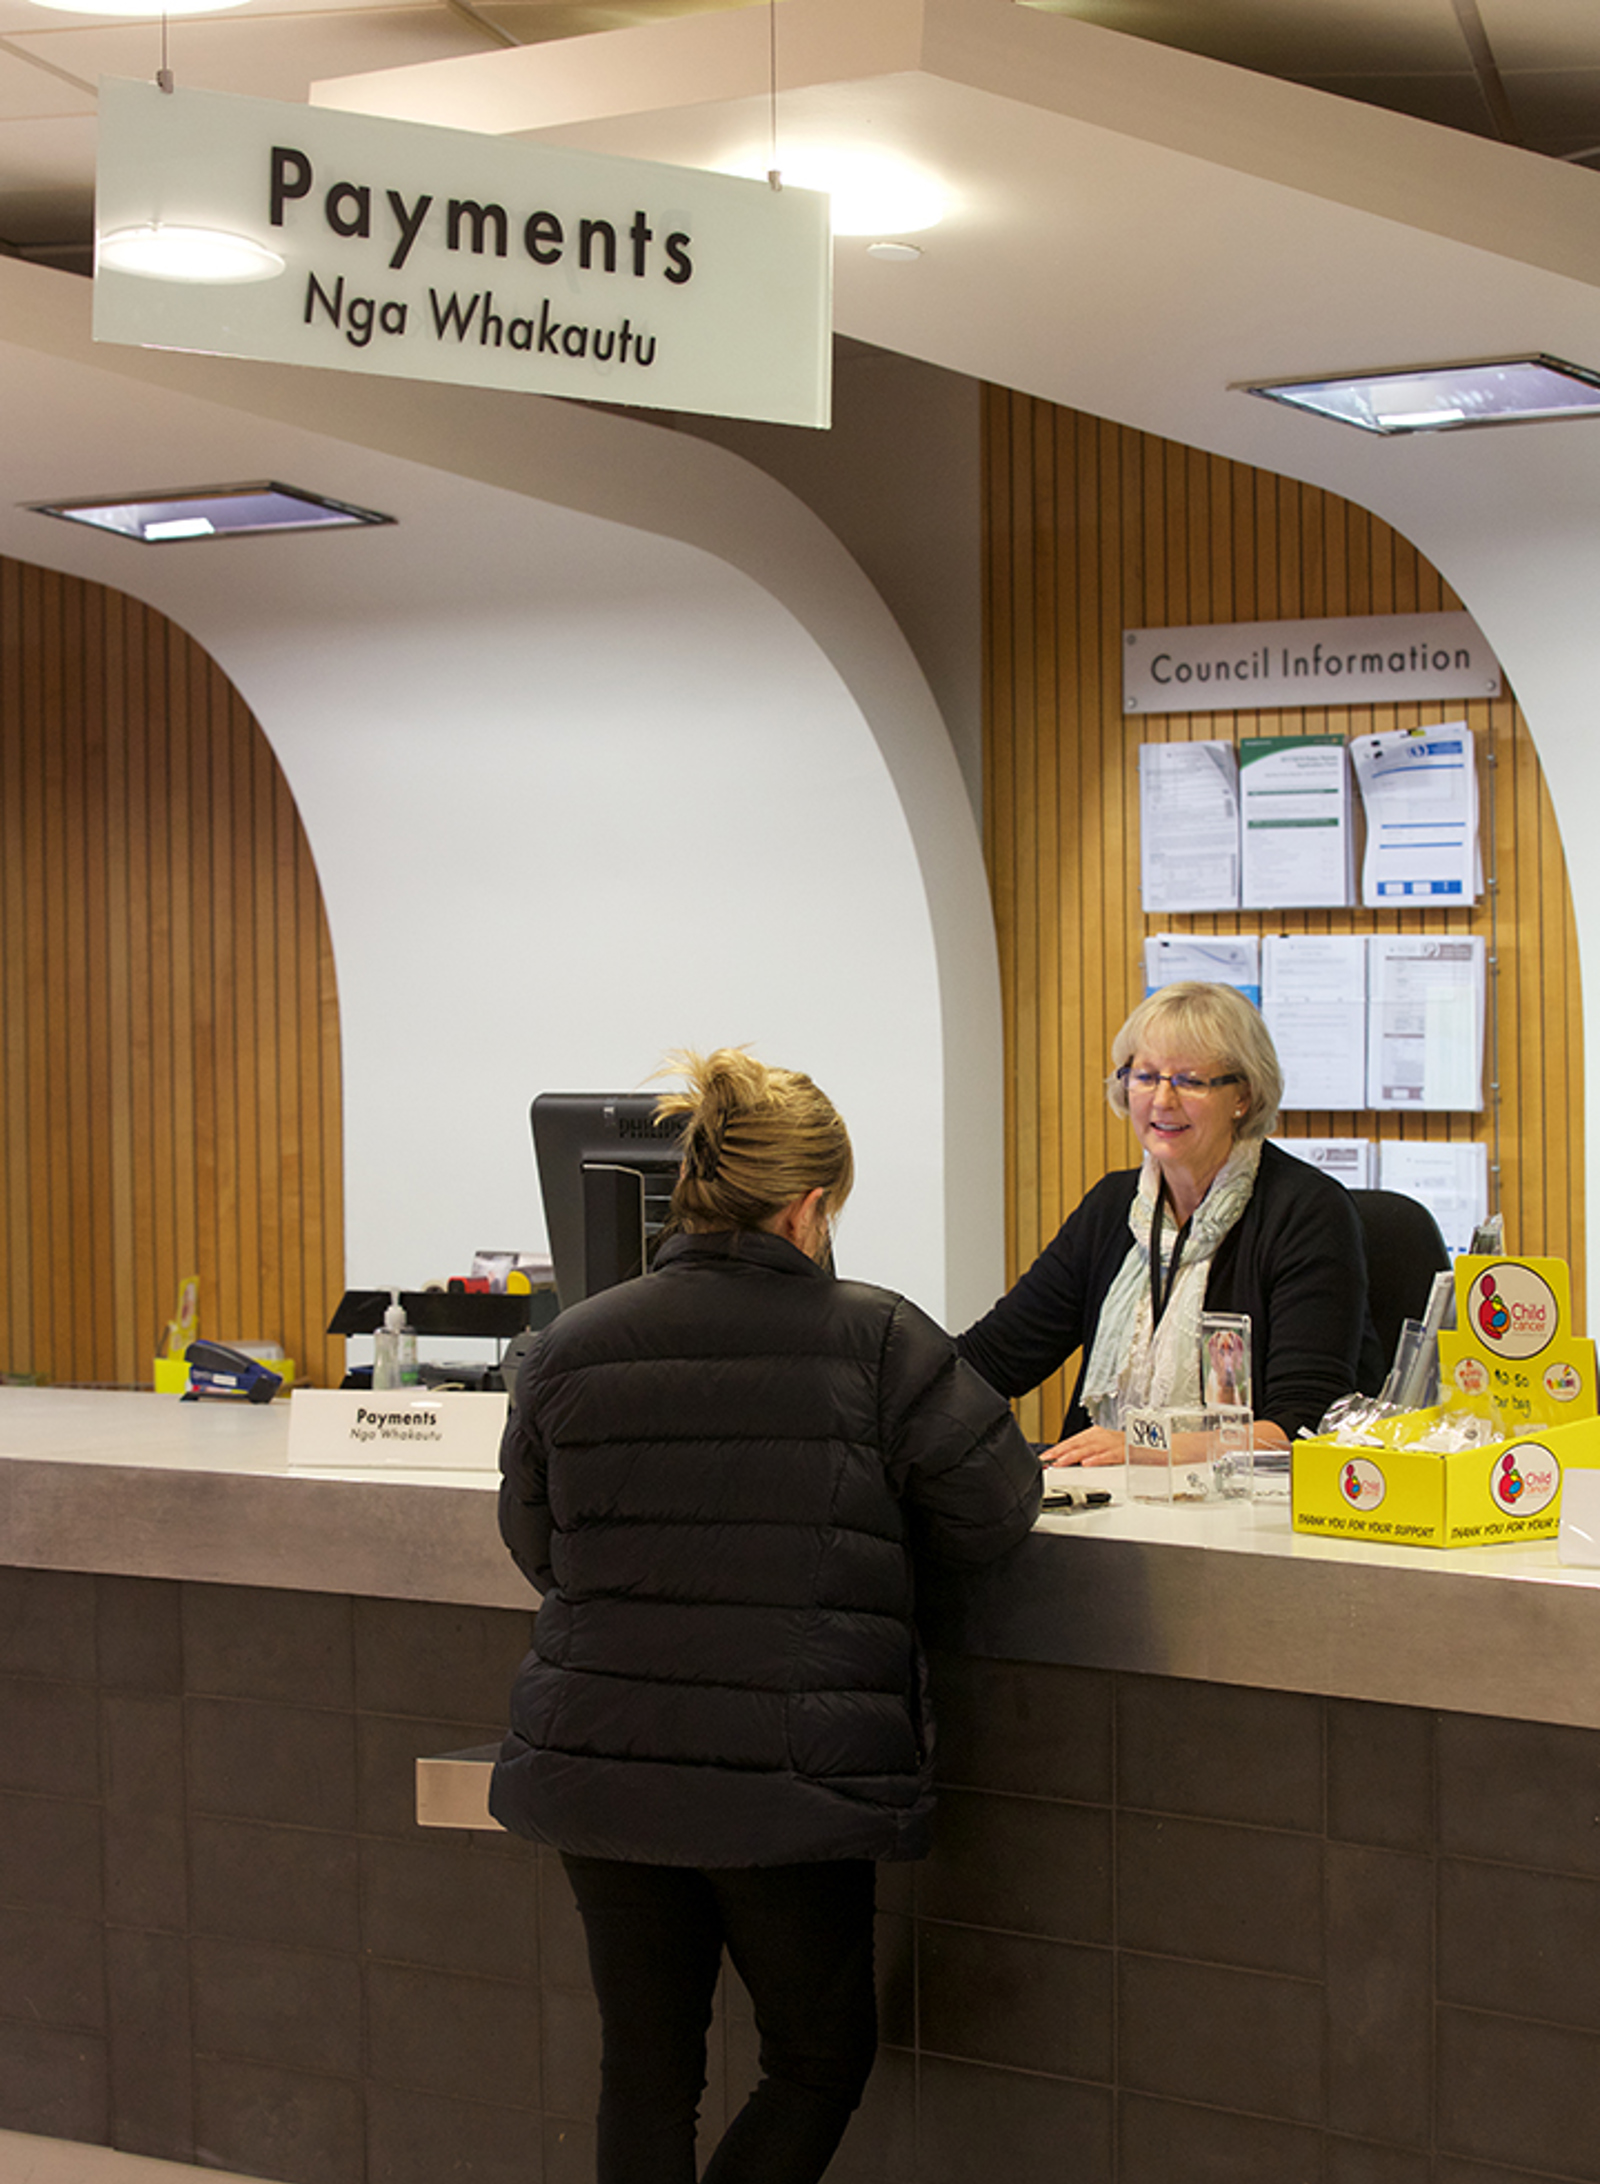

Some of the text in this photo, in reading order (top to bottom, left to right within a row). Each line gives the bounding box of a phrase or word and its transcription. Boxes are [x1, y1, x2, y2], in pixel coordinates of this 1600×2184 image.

[269, 145, 694, 285] Payments
[303, 272, 657, 366] Nga Whakautu
[1150, 643, 1471, 684] Council Information
[1511, 1302, 1546, 1321] Child
[356, 1407, 437, 1429] Payments
[350, 1427, 443, 1442] Nga Whakautu
[1133, 1418, 1168, 1449] SPCA
[1297, 1512, 1435, 1539] THANK YOU FOR YOUR SUPPORT
[1450, 1525, 1481, 1540] THANK
[1484, 1522, 1505, 1536] YOU
[1505, 1519, 1527, 1534] FOR
[1528, 1516, 1555, 1531] YOUR
